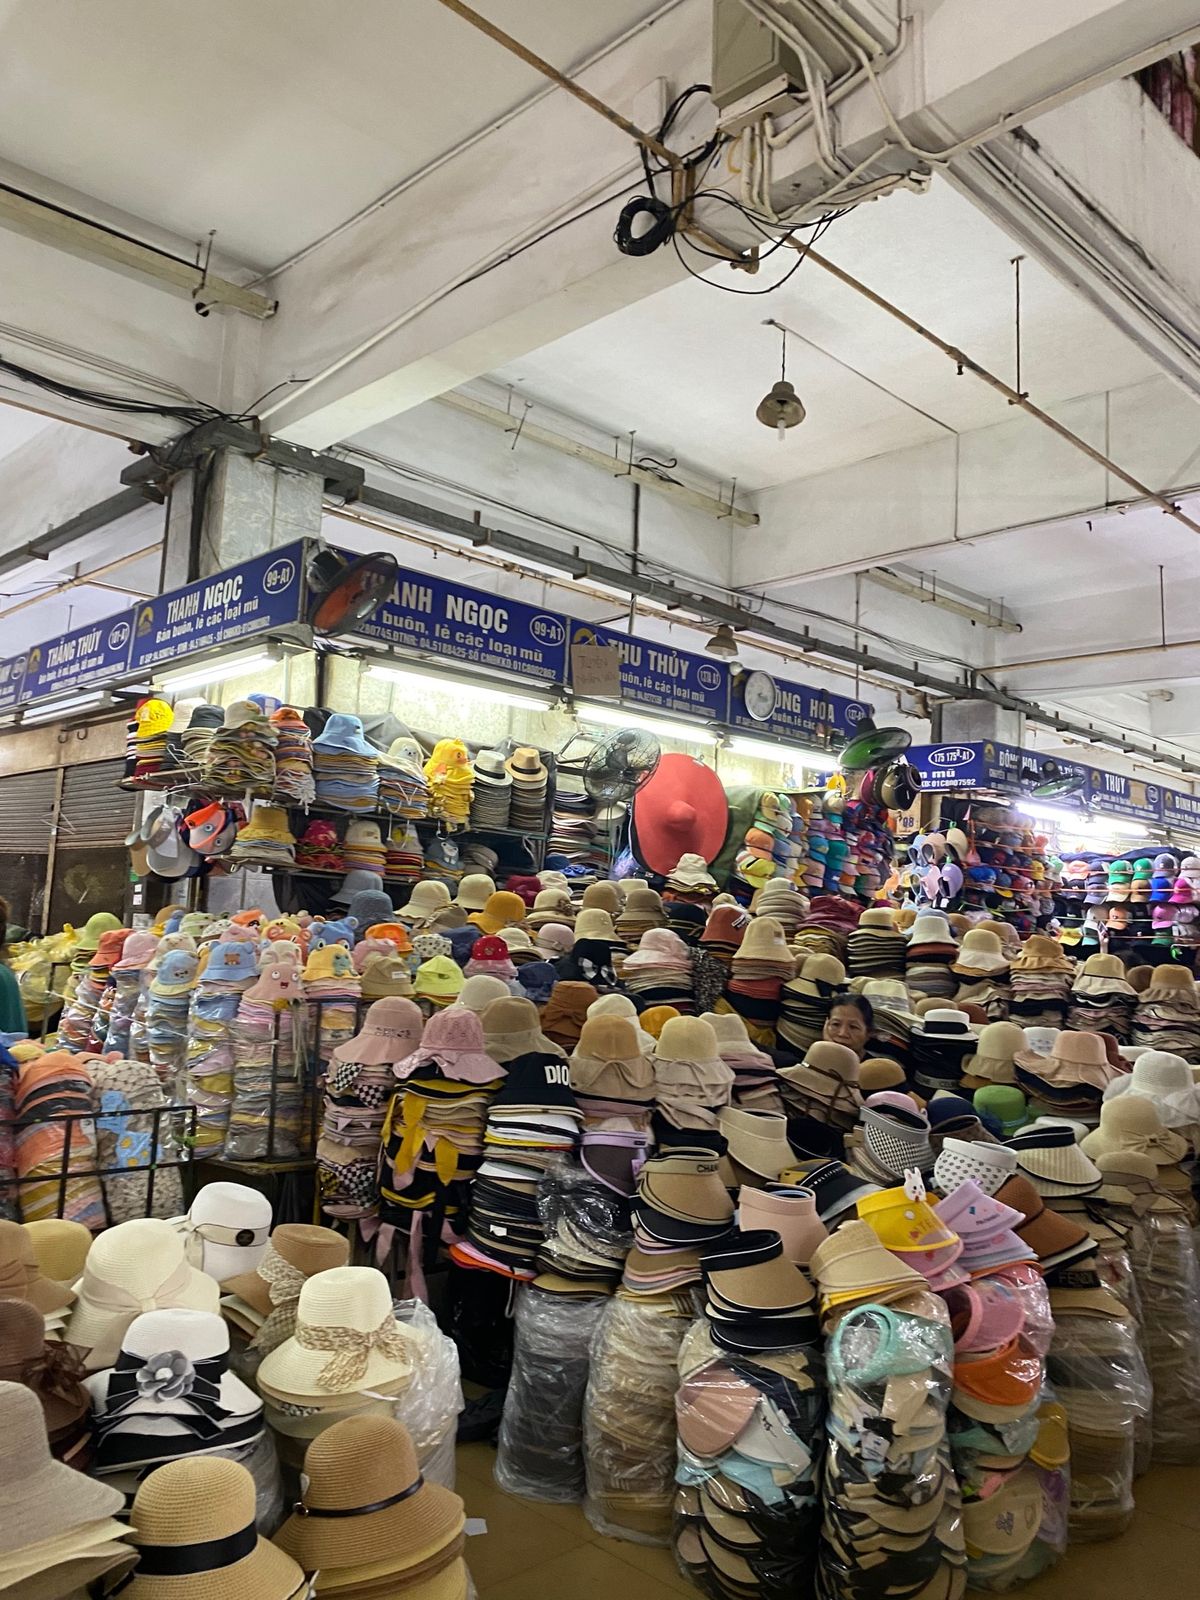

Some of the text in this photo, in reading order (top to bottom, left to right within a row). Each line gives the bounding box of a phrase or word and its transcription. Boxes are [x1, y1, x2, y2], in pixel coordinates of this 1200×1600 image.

[267, 567, 291, 588] 99-A1
[166, 575, 243, 625] THANH NGỌC
[446, 594, 509, 634] NGỌC
[455, 631, 484, 648] các
[534, 621, 561, 641] 99-A1
[648, 650, 689, 680] THỦY
[934, 753, 945, 763] 175
[932, 768, 956, 778] mũ
